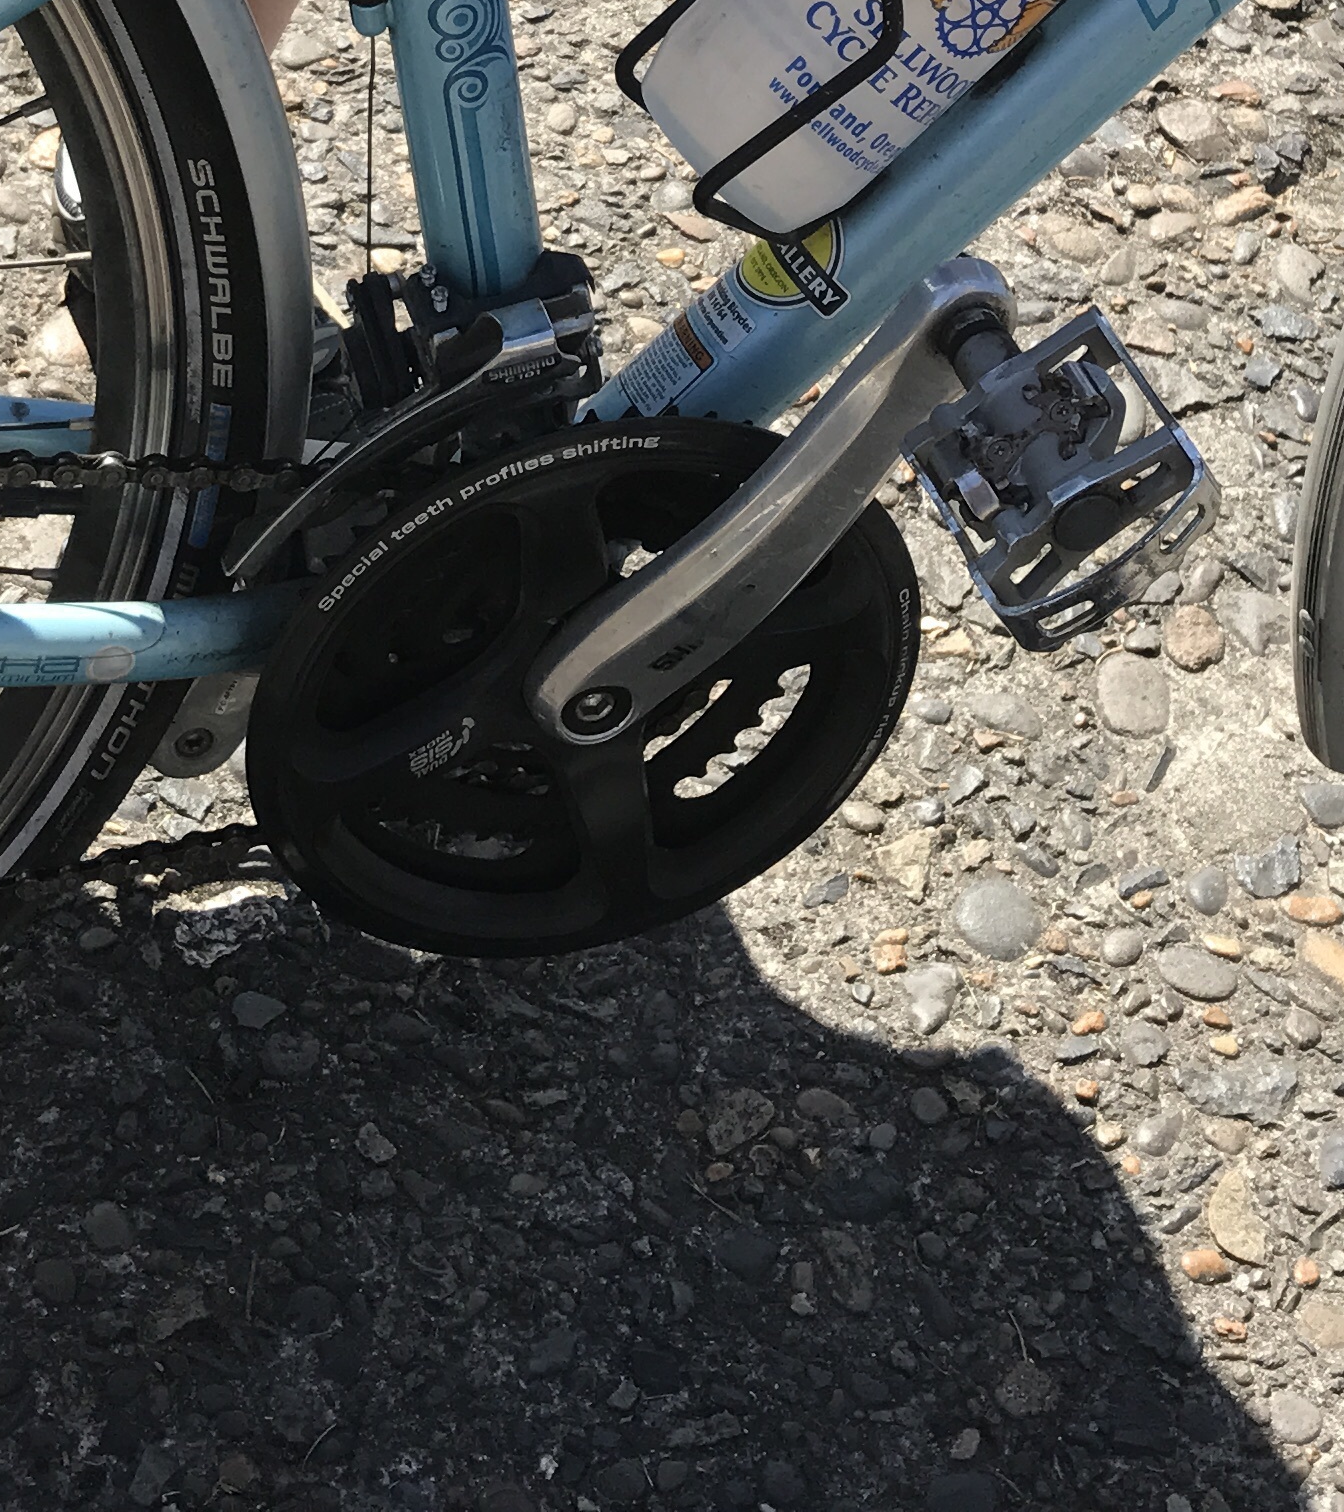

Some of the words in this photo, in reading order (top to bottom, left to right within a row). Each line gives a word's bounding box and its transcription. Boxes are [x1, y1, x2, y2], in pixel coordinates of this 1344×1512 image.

[806, 0, 898, 94] CYCE
[785, 55, 873, 144] Porand,
[869, 132, 905, 159] Oreg
[186, 158, 234, 388] SCHWALBE
[776, 243, 841, 306] ALLERY
[727, 300, 753, 334] Bicycles
[488, 356, 556, 381] SHIMANO
[318, 541, 389, 612] Special
[390, 496, 454, 541] teeth
[459, 453, 556, 500] profiles
[562, 435, 661, 460] shifting
[408, 730, 450, 758] INDEX
[410, 736, 454, 772] SIS
[414, 755, 449, 779] DUAL
